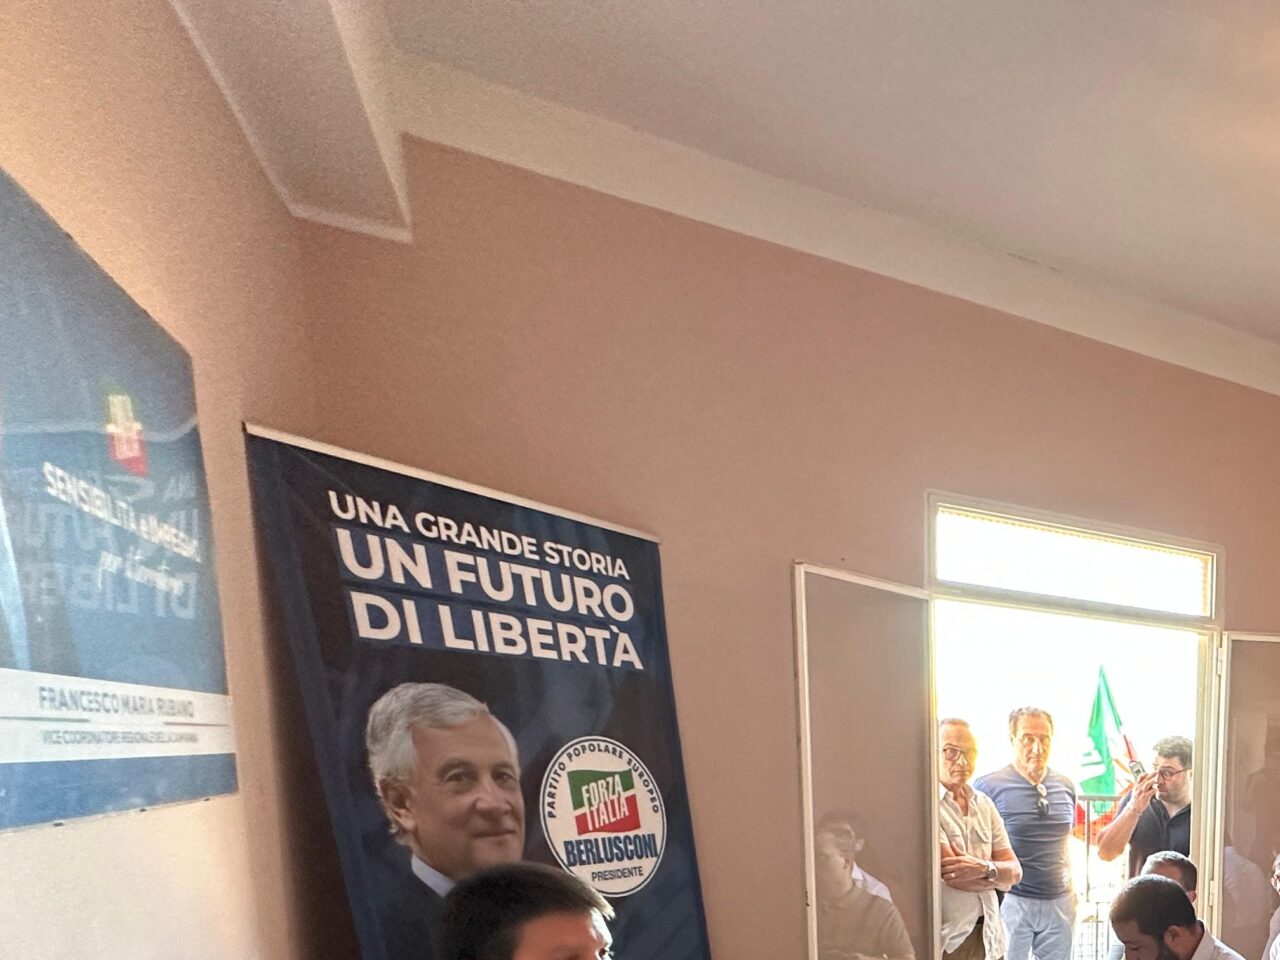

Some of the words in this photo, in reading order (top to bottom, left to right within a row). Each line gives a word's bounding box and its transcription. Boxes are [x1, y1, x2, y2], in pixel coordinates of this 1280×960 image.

[328, 490, 411, 532] UNA
[414, 512, 541, 560] GRANDE
[545, 541, 630, 581] STORIA
[335, 527, 433, 589] UN
[443, 549, 635, 622] FUTURO
[350, 590, 423, 645] DI
[438, 604, 644, 670] LIBERTÀ
[38, 686, 120, 714] FRANCESCO
[121, 693, 155, 716] MARIA
[547, 762, 566, 818] PARTITO
[566, 743, 624, 762] POPOLARE
[627, 757, 660, 814] EUROPEO
[581, 774, 624, 808] FORZA
[587, 796, 630, 831] ITALIA
[563, 833, 658, 867] BERLUSCONI
[591, 866, 644, 882] PRESIDENTE
